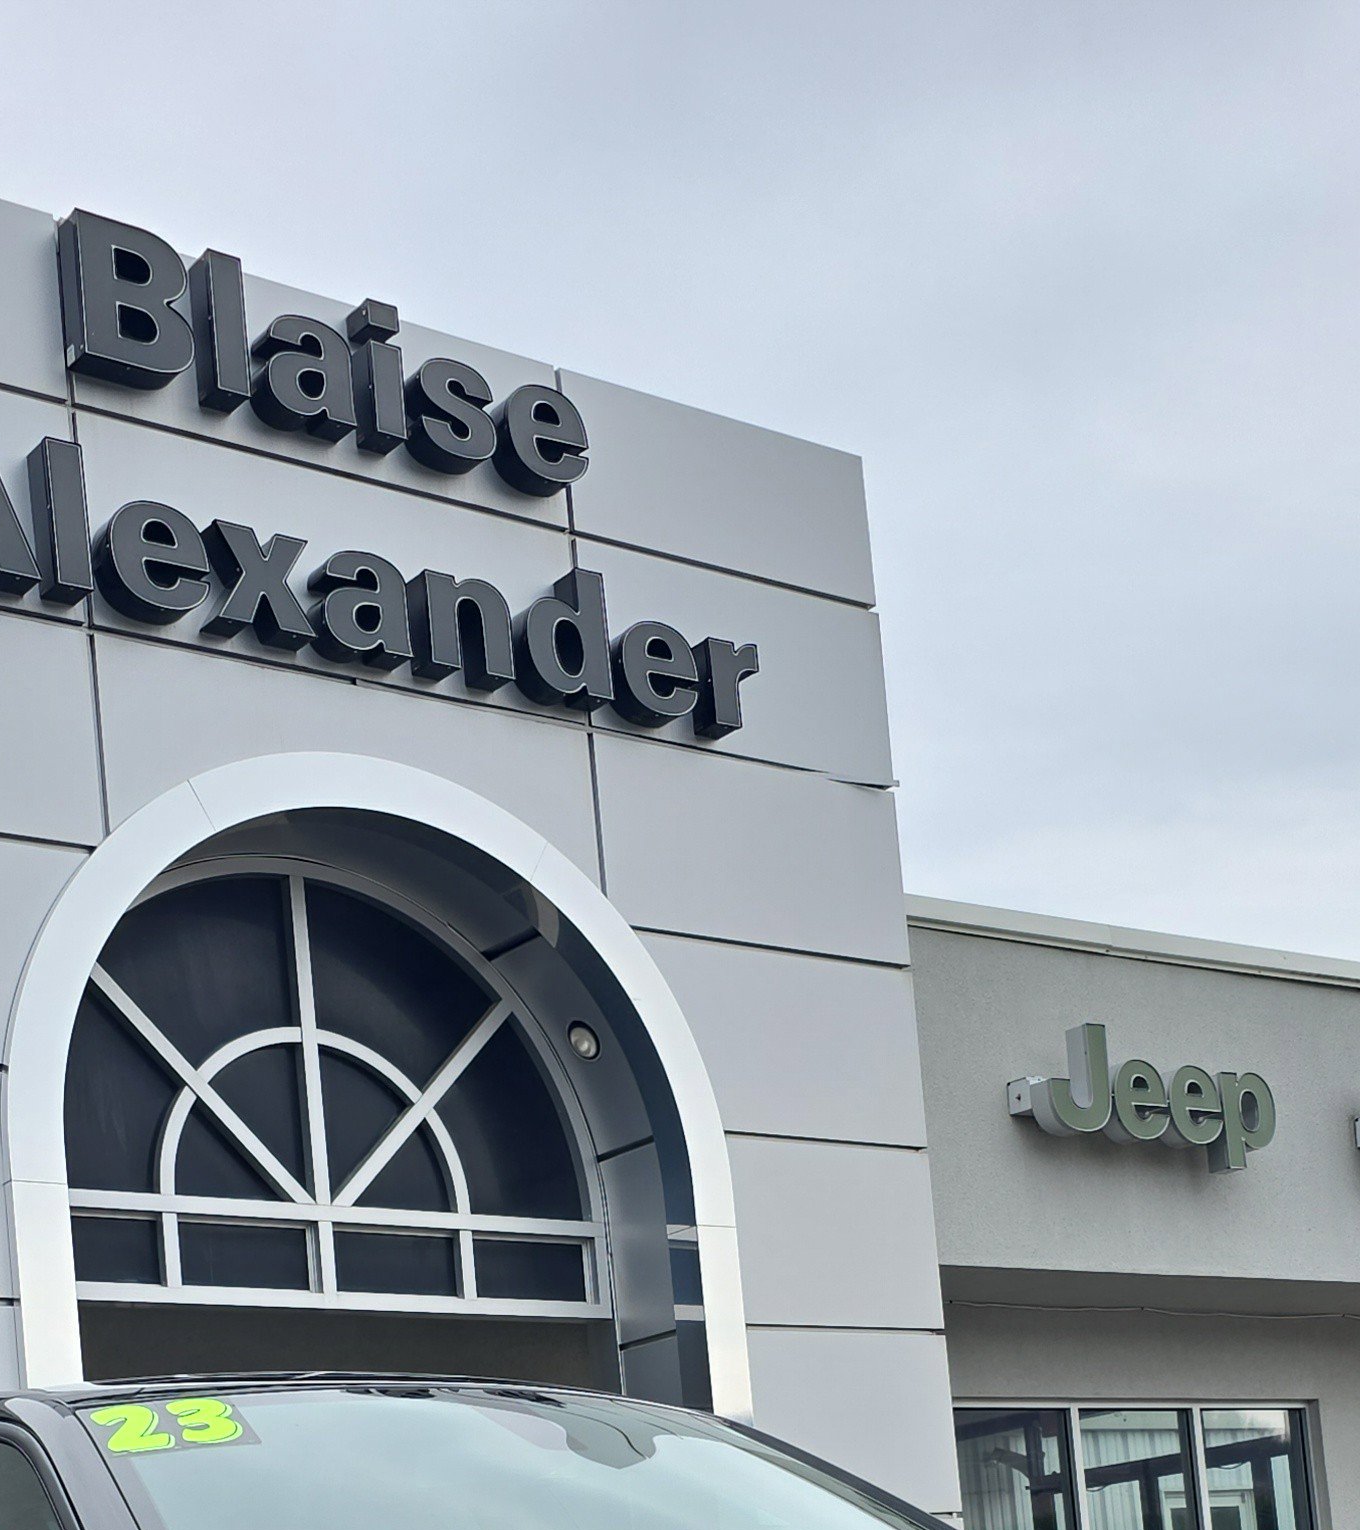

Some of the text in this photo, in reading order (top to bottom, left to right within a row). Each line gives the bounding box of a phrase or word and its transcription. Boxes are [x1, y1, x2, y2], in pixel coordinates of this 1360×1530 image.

[55, 208, 590, 497] Blaise
[1030, 1023, 1277, 1174] Jeep
[90, 1398, 244, 1453] 23
